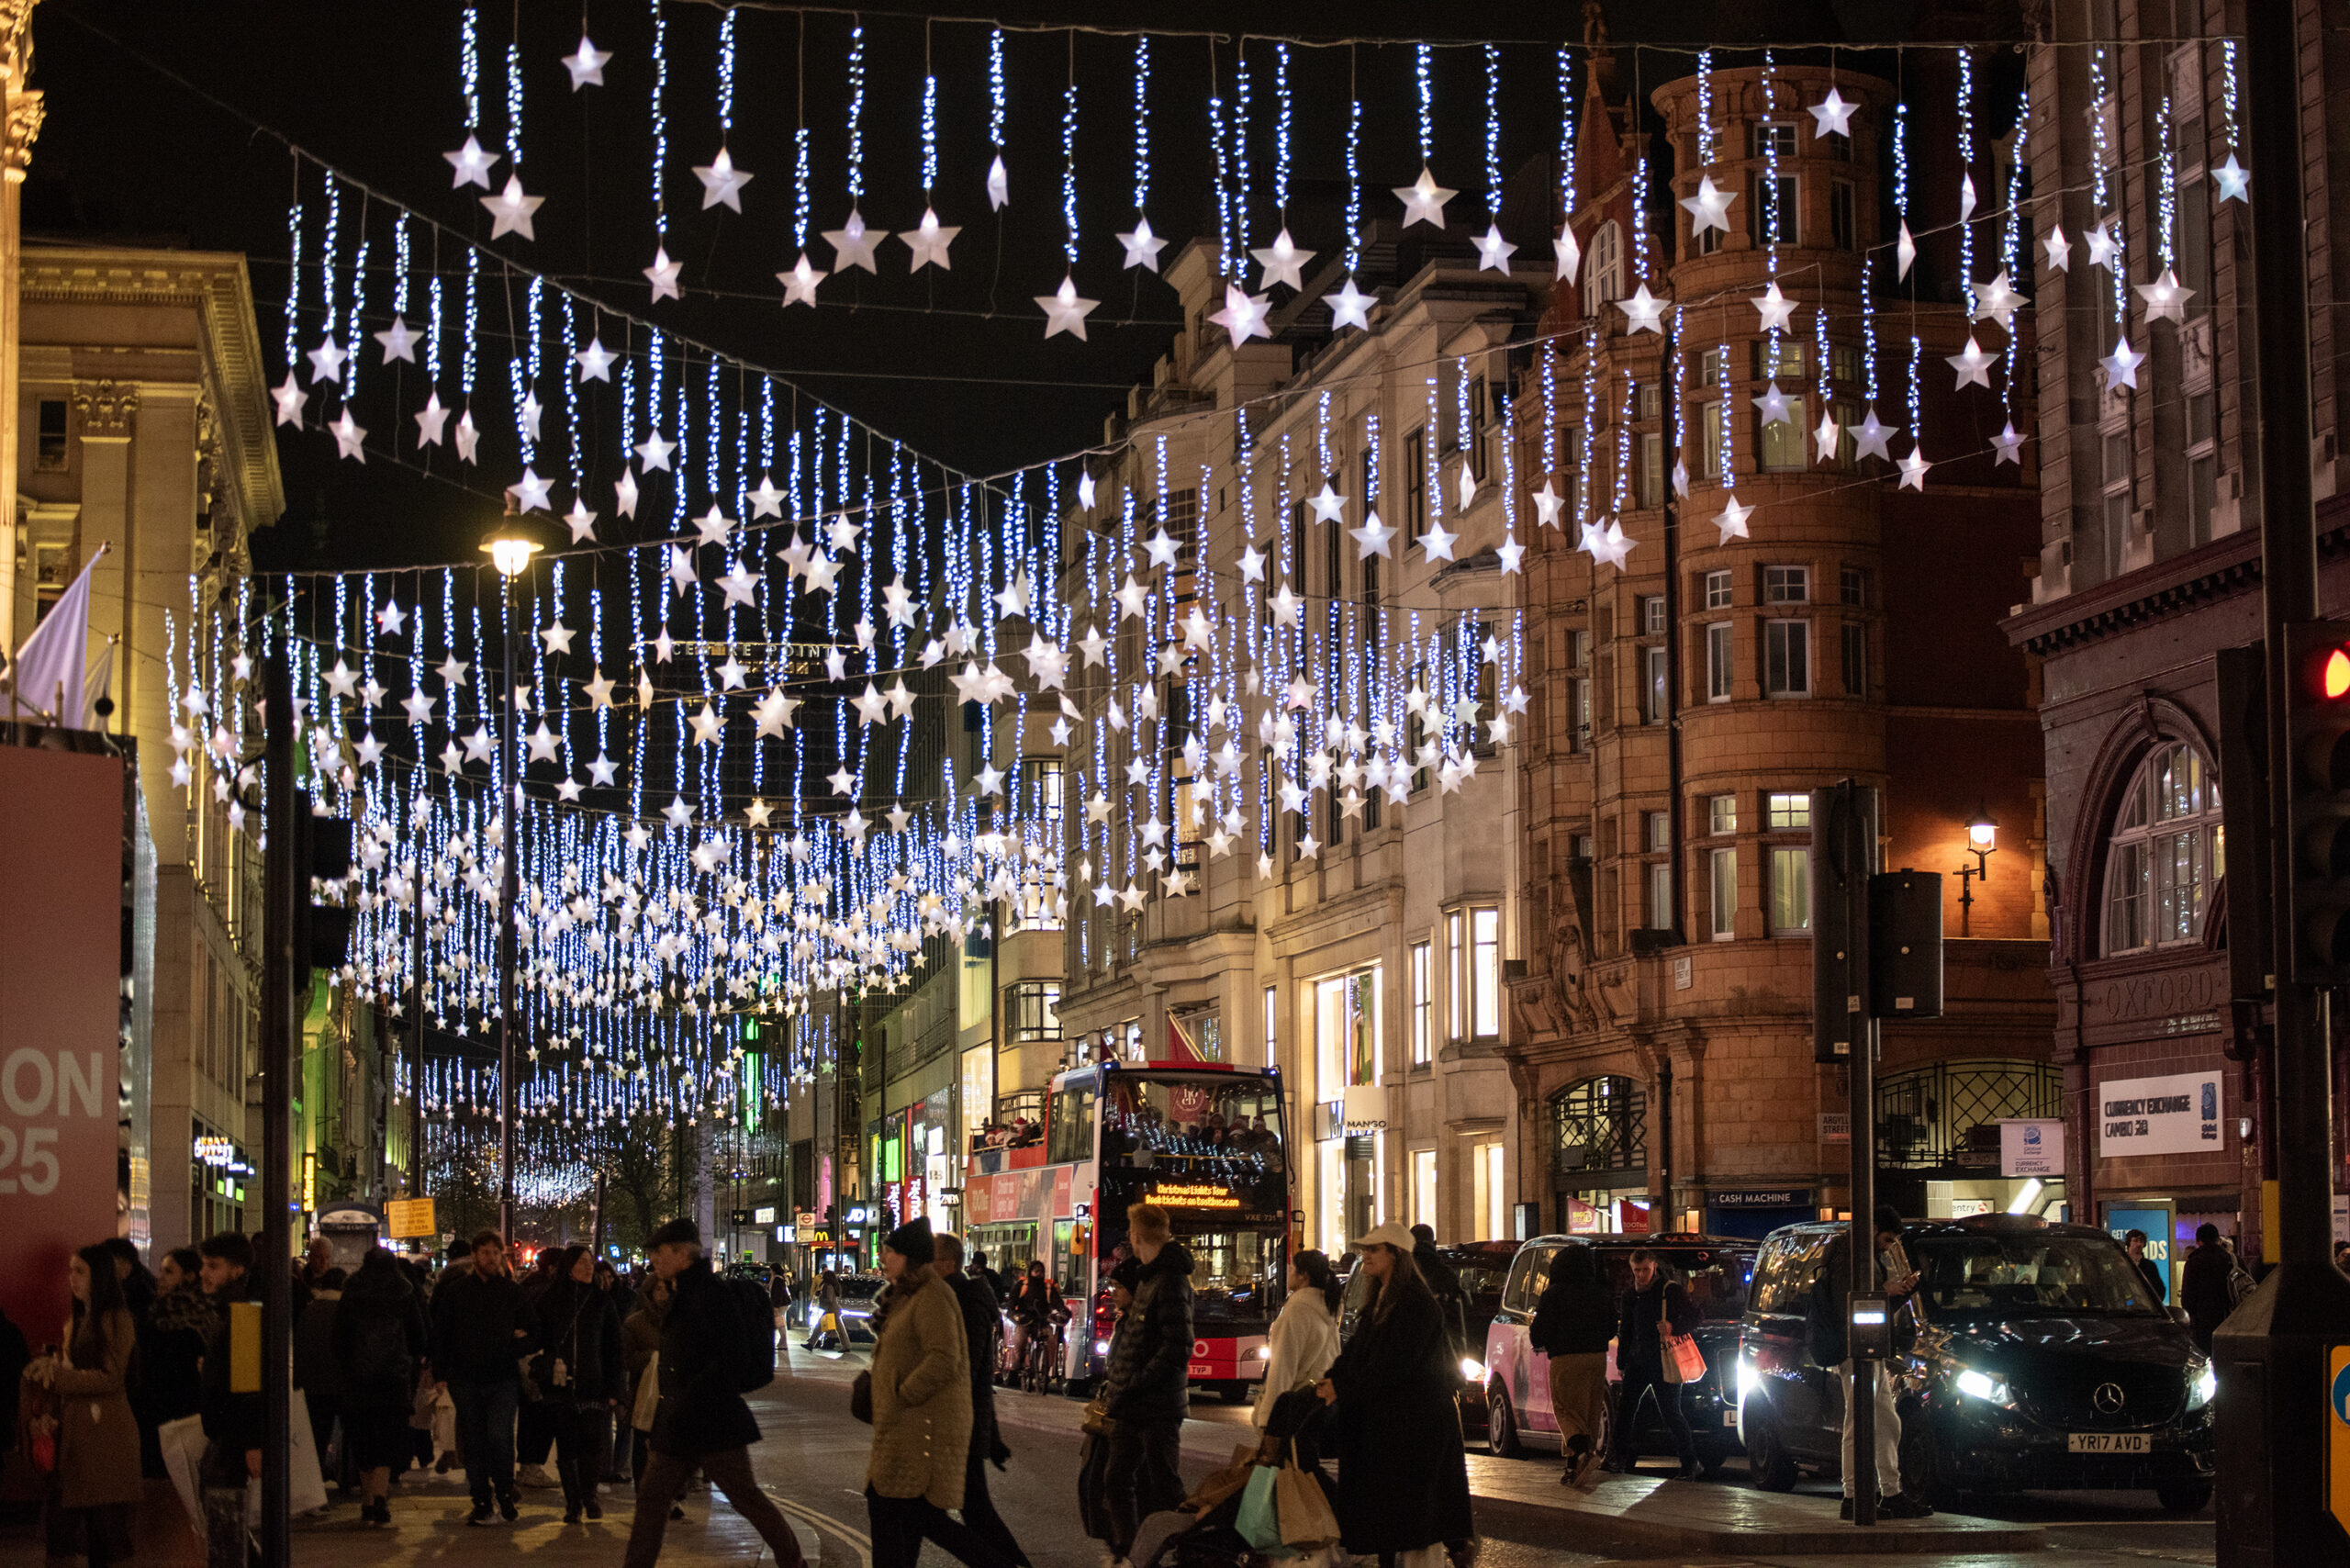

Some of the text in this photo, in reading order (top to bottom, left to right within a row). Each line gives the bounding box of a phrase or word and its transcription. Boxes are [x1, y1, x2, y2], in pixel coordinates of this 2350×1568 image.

[2107, 970, 2213, 1018] OXFORD
[2105, 1094, 2190, 1117] CURRENCY EXCHANGE
[1347, 1120, 1387, 1128] MANGO
[1823, 1115, 1849, 1125] ARGYLL
[1823, 1126, 1850, 1134] STREET
[2105, 1121, 2133, 1137] CAMBIO
[1157, 1184, 1190, 1195] Christmas
[1212, 1186, 1228, 1196] Tour
[940, 1194, 959, 1204] ZARA
[1718, 1193, 1791, 1204] CASH MACHINE
[1953, 1204, 1975, 1213] entry
[846, 1208, 866, 1223] JD
[2111, 1229, 2124, 1239] GET
[1192, 1366, 1207, 1374] TVP
[2077, 1435, 2142, 1450] YR17 AVD
